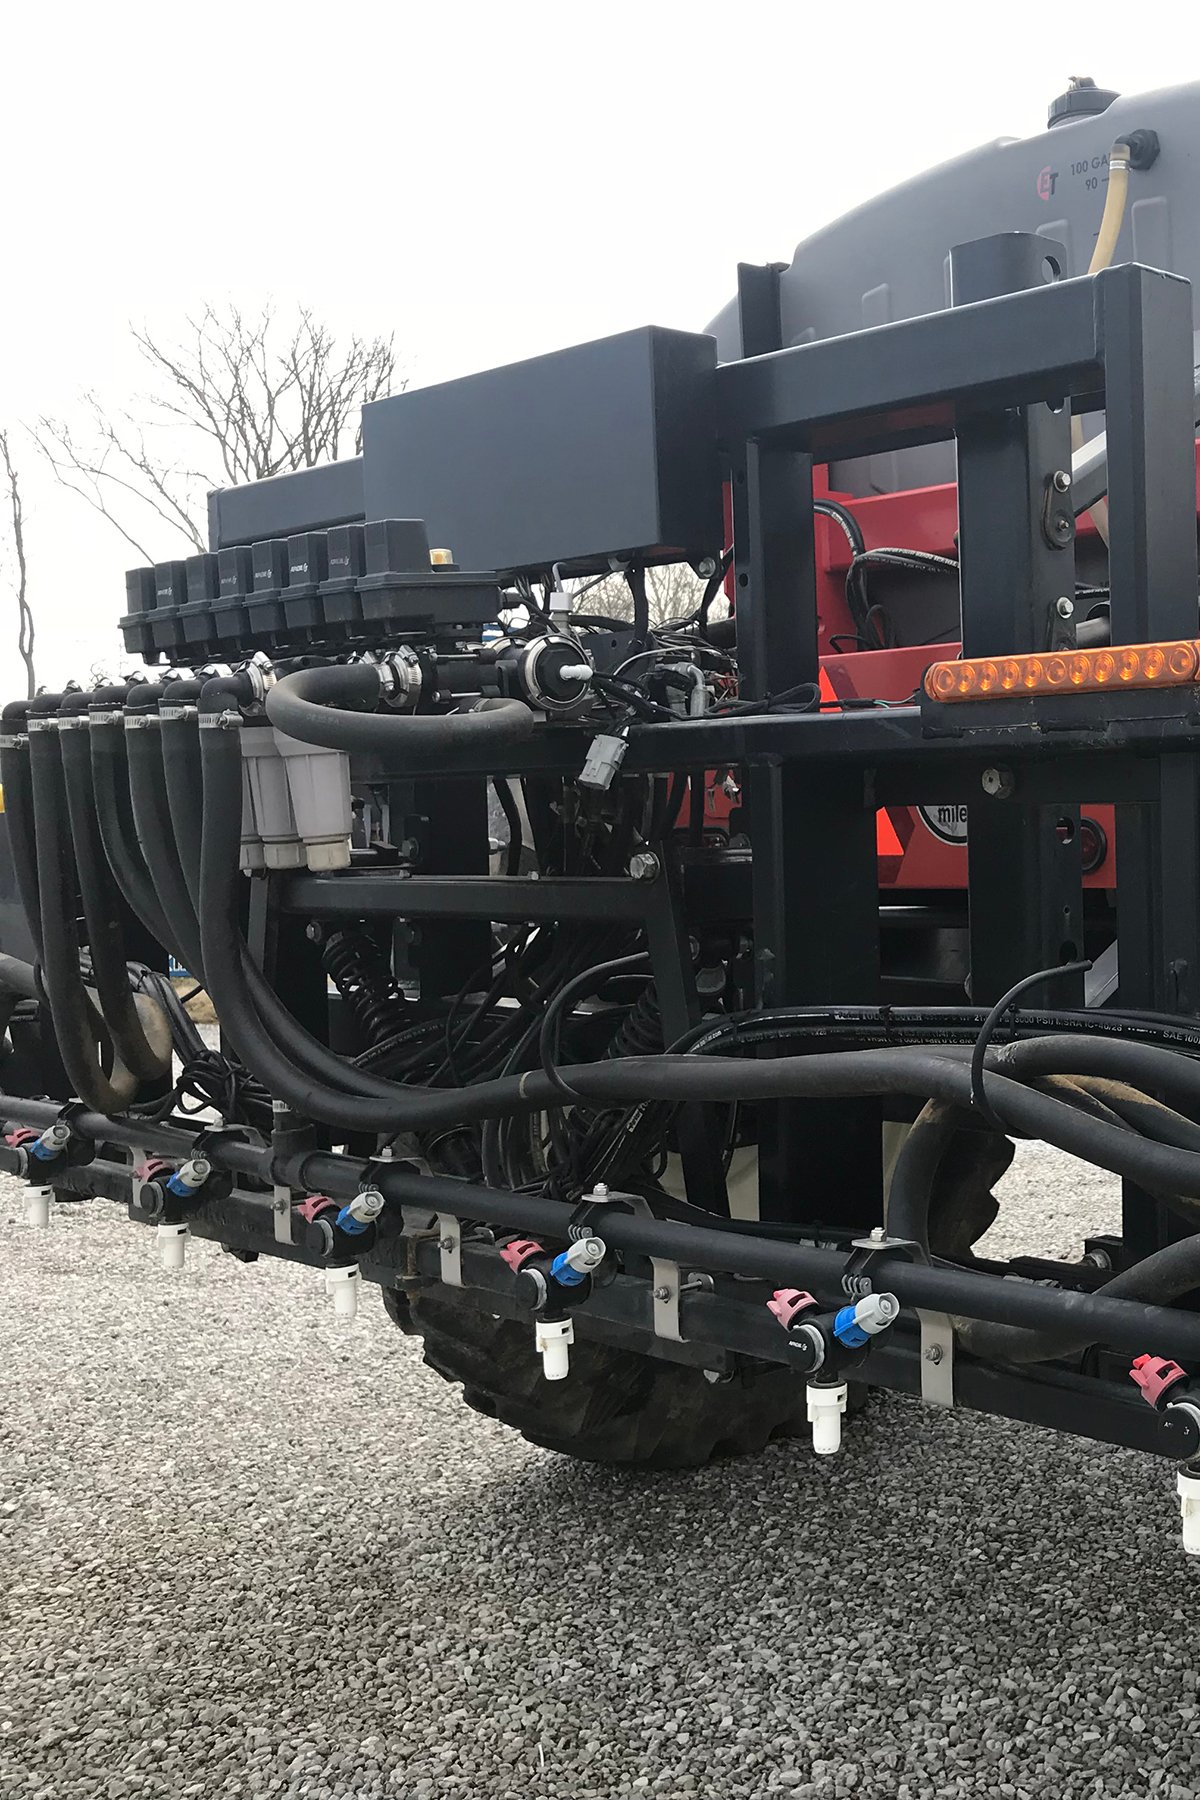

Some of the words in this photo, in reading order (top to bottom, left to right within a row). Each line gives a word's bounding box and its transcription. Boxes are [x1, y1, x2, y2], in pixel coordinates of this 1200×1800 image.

[1071, 160, 1089, 176] 100
[1091, 153, 1111, 169] GA
[1085, 177, 1098, 191] 90
[1162, 1030, 1183, 1042] SAE
